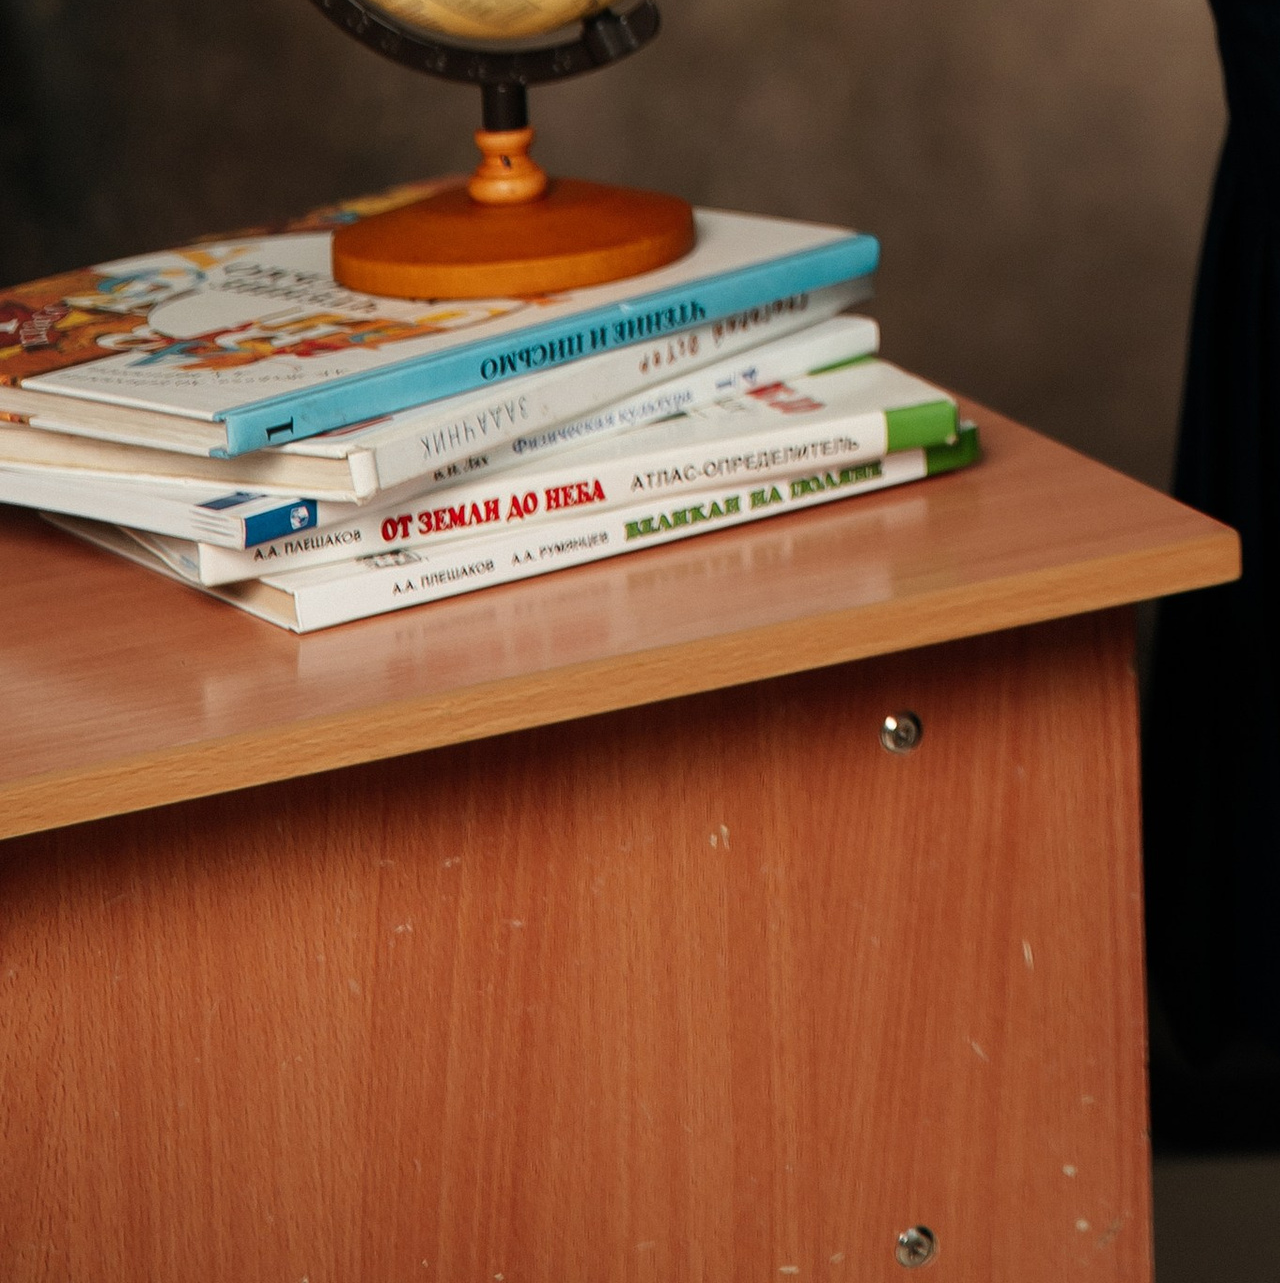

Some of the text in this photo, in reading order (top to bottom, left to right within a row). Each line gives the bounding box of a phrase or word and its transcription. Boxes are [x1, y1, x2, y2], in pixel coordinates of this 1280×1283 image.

[480, 300, 706, 381] ЧТЕНИЕ И ПИСЬМО
[420, 396, 529, 459] ЗАДАЧНИК
[512, 411, 615, 454] Физическая
[253, 436, 861, 562] А.А. ПЛЕШАКОВ ОТ ЗЕМЛИ ДО НЕБА АТЛАС-ОПРЕДЕЛИТЕЛЬ
[391, 459, 883, 597] А.А. ПЛЕШАКОВ А.А. РУМЯНЦЕВ ВЕЛИКАН НА ПОЛЯНЕ
